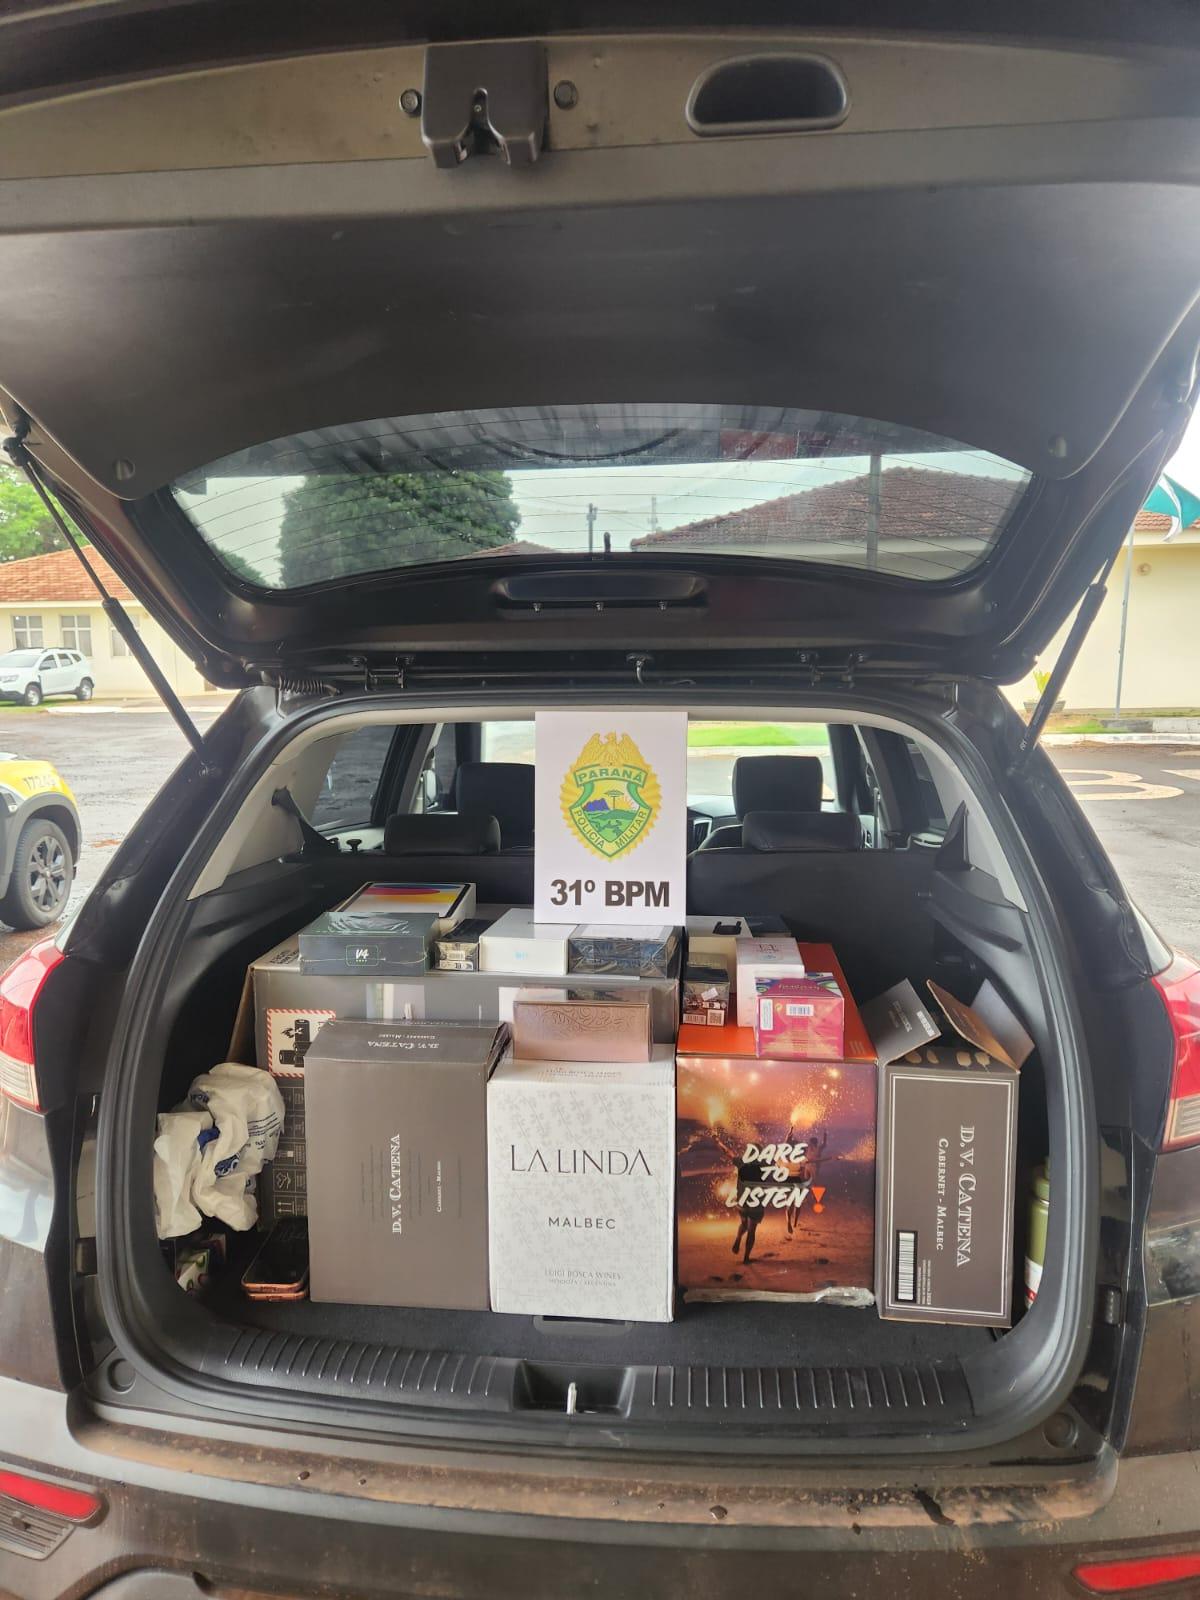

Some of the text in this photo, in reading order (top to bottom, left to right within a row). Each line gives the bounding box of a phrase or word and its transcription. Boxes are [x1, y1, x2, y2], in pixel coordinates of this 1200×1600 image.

[578, 768, 644, 782] PARANÁ
[615, 810, 648, 848] MILITAR
[550, 879, 670, 907] 31º BPM
[390, 1134, 401, 1201] CATENA
[511, 1144, 652, 1176] LA LINDA
[742, 1143, 808, 1164] DARE
[937, 1138, 948, 1196] CABERNET
[761, 1166, 789, 1182] TO
[548, 1217, 616, 1230] MALBEC
[936, 1206, 947, 1250] MALBEC
[957, 1173, 976, 1267] CATENA
